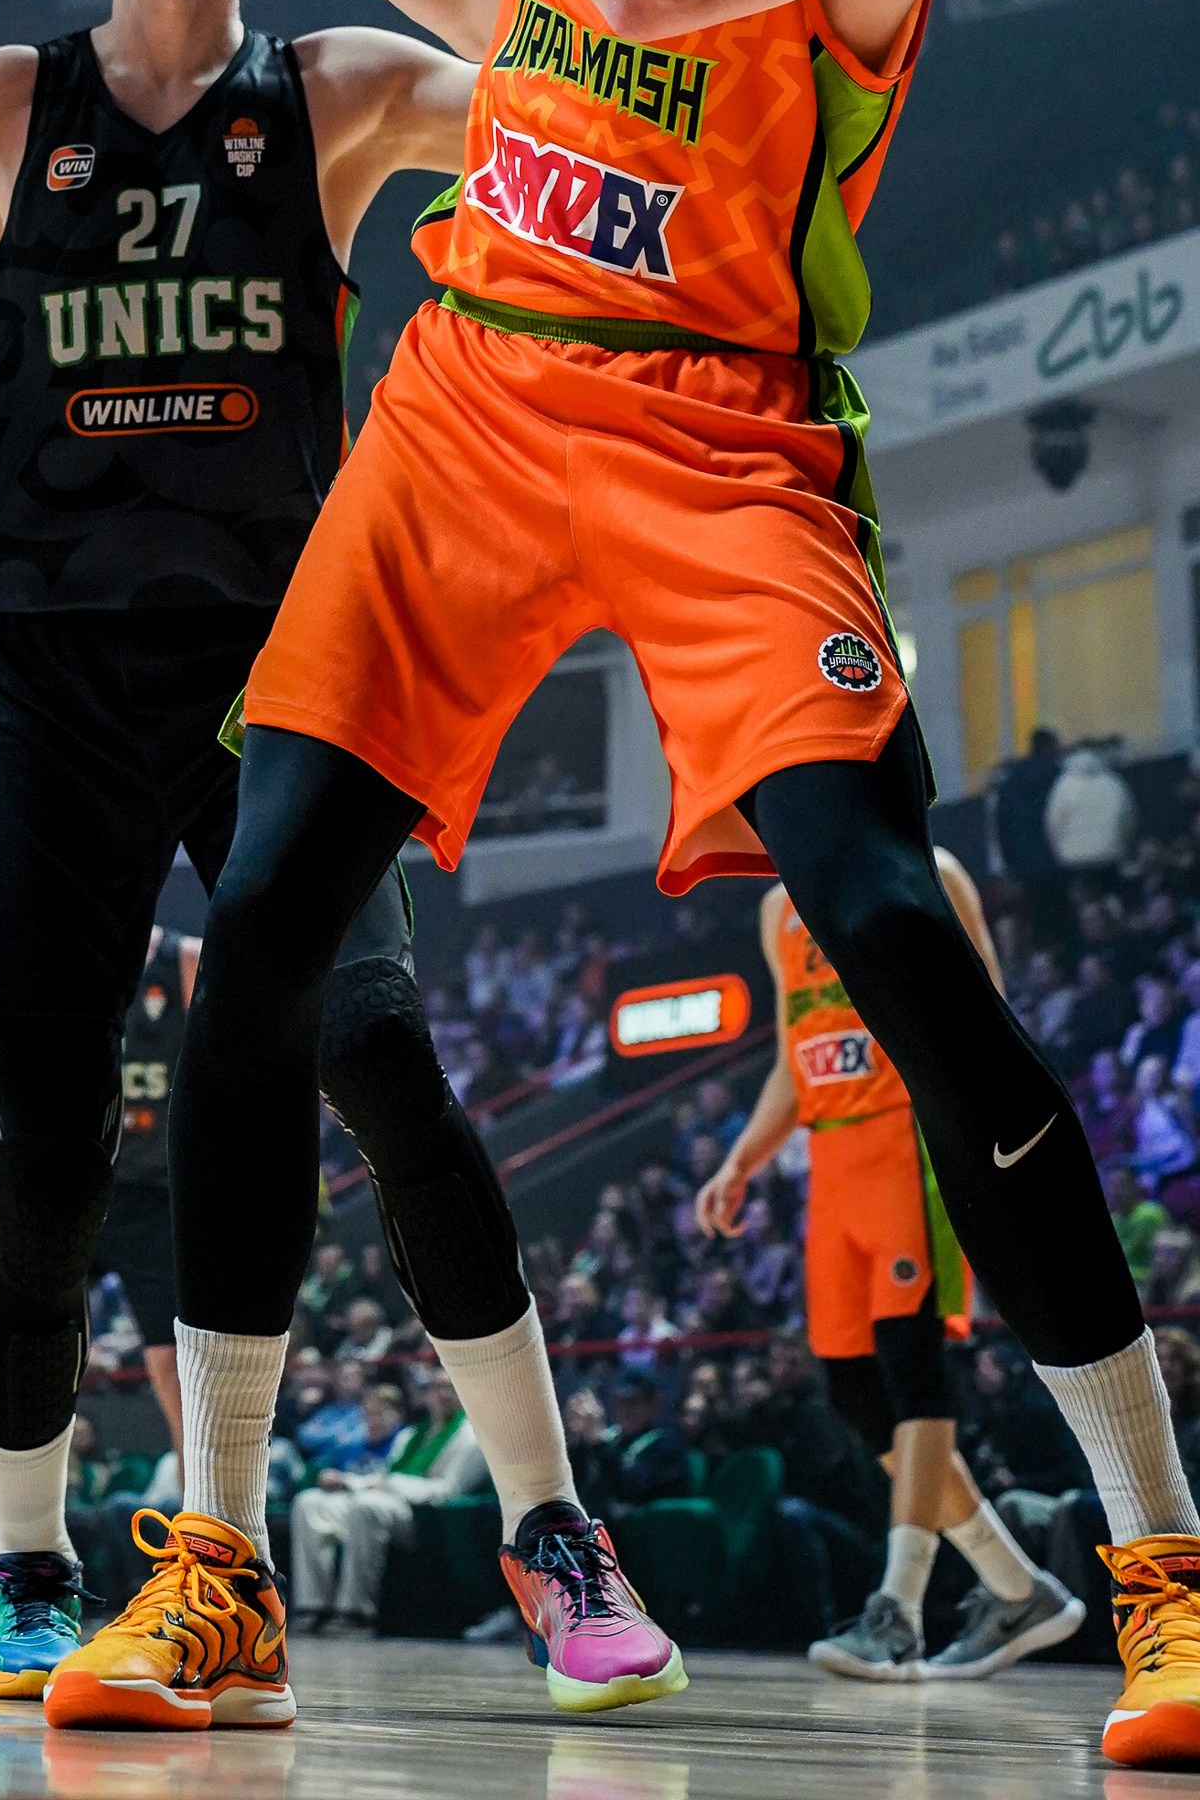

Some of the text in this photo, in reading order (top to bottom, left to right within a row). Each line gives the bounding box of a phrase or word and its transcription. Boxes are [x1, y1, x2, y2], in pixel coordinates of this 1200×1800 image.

[224, 137, 266, 151] WINLINE
[58, 159, 91, 175] WIN
[236, 164, 255, 178] CUP
[117, 184, 201, 263] 27
[41, 277, 286, 367] UNICS
[83, 395, 215, 427] WINLINE
